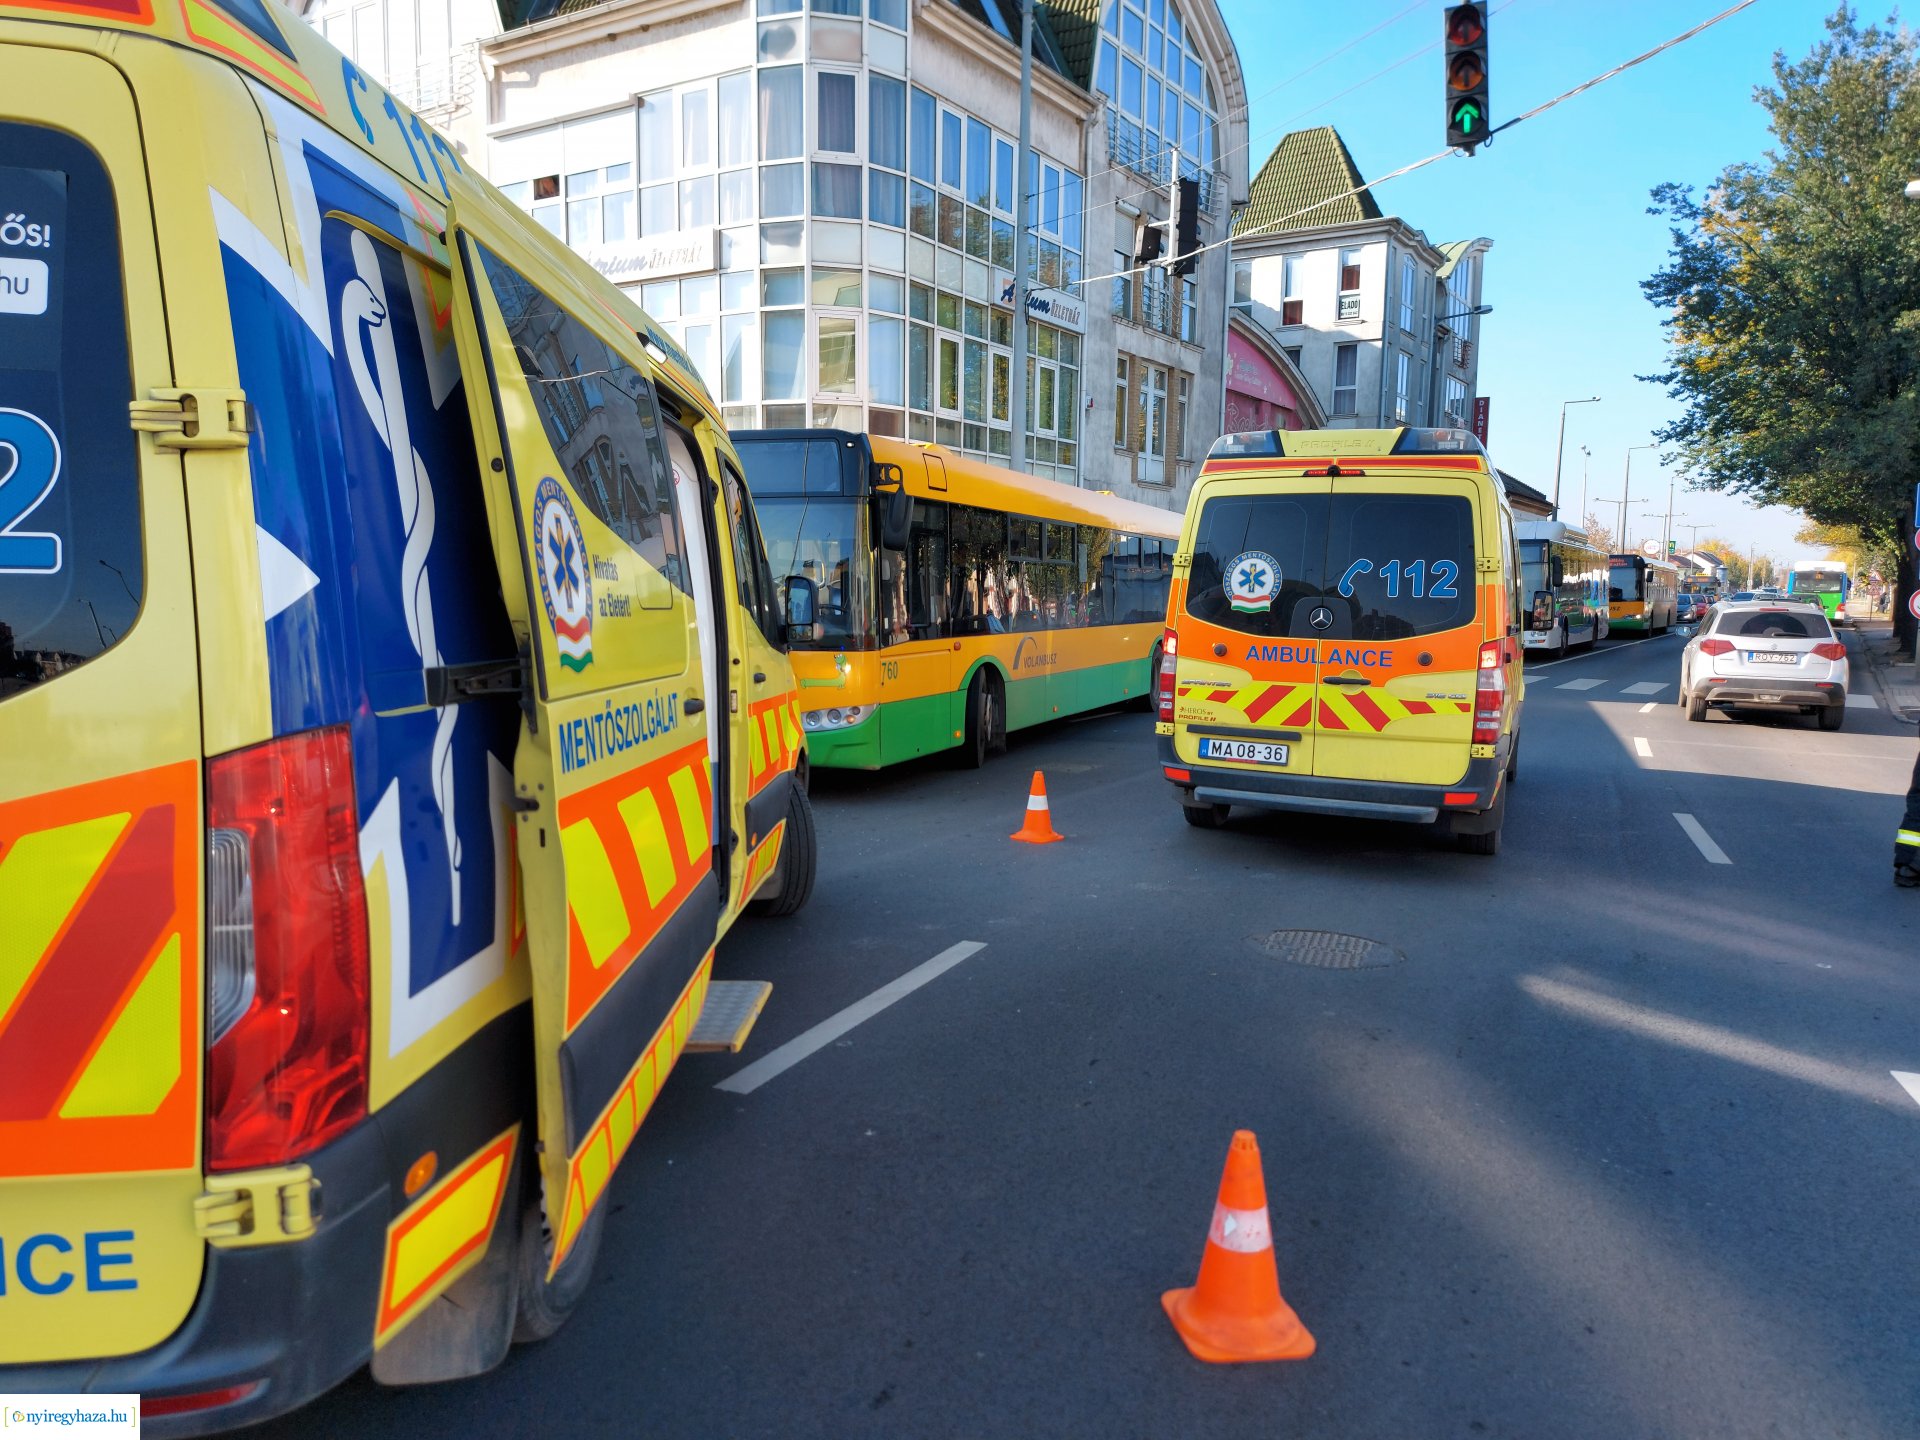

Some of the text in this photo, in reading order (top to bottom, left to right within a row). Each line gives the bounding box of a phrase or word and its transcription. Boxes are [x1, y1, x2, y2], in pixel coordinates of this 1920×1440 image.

[592, 554, 619, 582] Hivatás
[1379, 559, 1459, 598] 112
[599, 598, 608, 617] az
[1245, 645, 1393, 667] AMBULANCE
[881, 661, 898, 681] 760
[559, 688, 678, 774] MENTŐSZOLGÁLAT
[1236, 744, 1283, 761] 08-36
